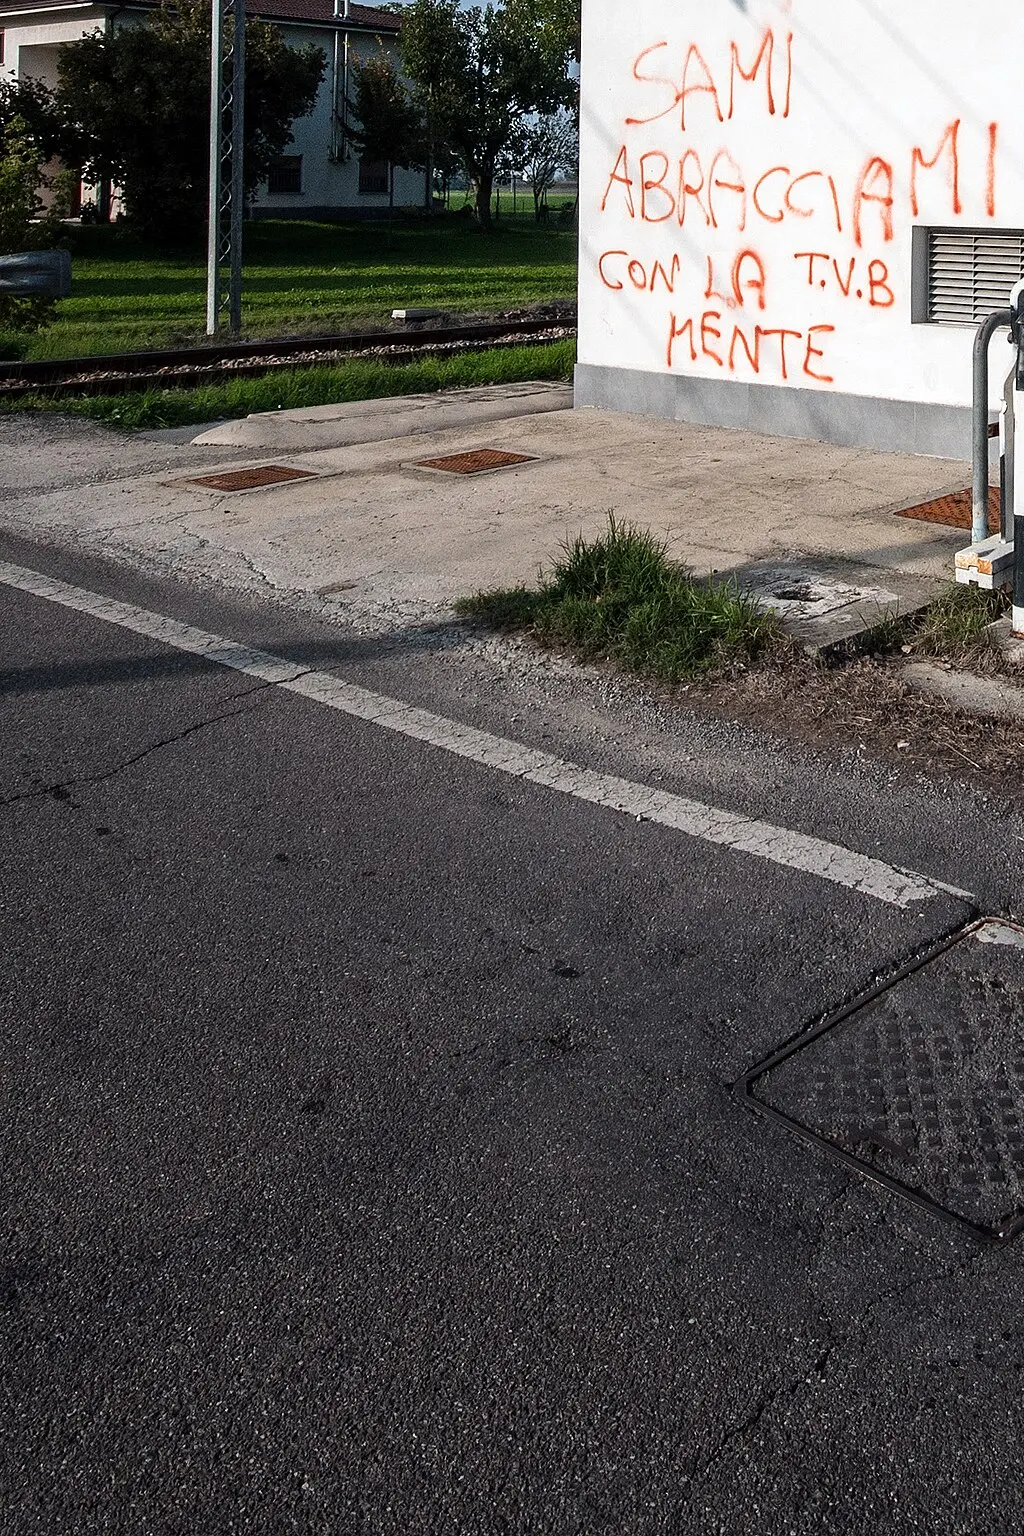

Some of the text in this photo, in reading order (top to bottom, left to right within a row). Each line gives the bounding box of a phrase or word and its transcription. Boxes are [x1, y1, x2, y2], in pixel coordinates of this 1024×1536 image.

[625, 24, 793, 131] SAMI
[598, 250, 680, 293] CON
[704, 249, 766, 311] LA
[665, 310, 836, 383] MENTE
